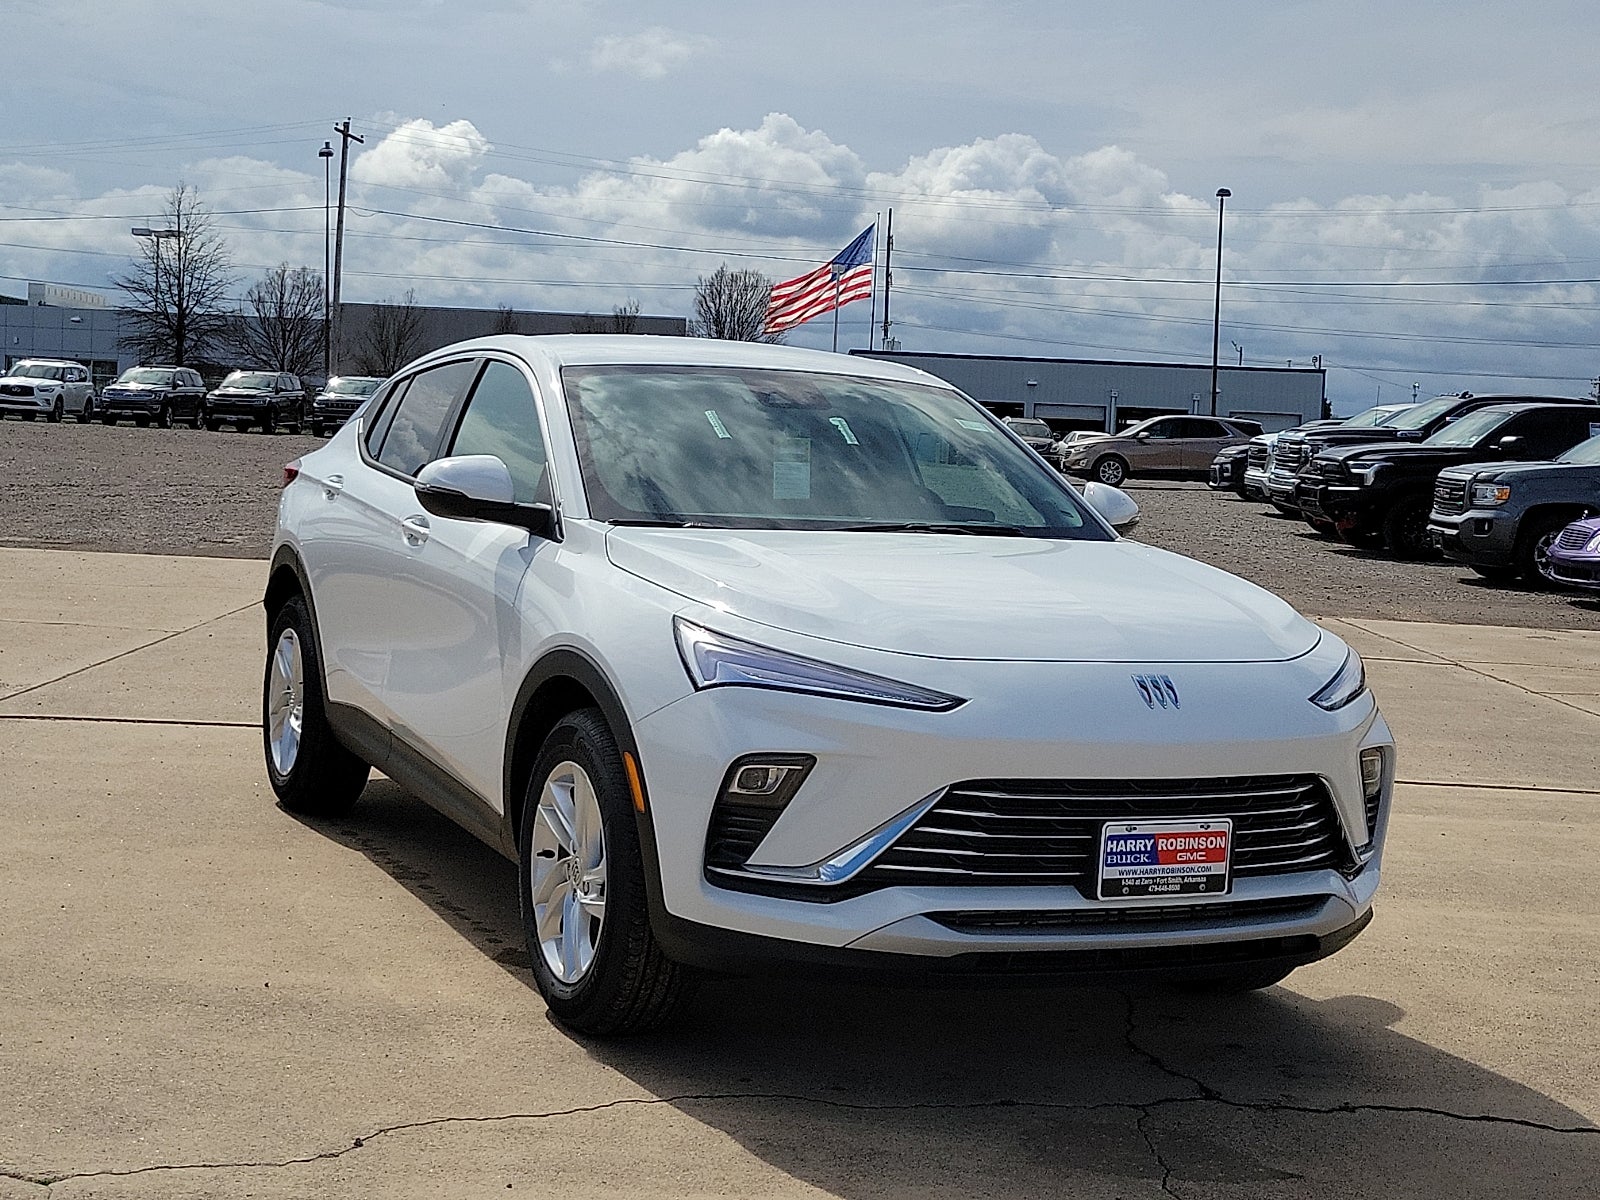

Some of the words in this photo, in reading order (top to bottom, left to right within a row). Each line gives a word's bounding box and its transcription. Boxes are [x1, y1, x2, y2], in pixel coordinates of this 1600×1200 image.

[1106, 839, 1155, 853] HARRY
[1157, 836, 1226, 851] ROBINSON
[1106, 854, 1150, 864] BUICK
[1176, 852, 1207, 861] GMC
[1118, 865, 1212, 876] WWW.HARRYROBINSON.COM
[1184, 875, 1207, 883] Arkansas
